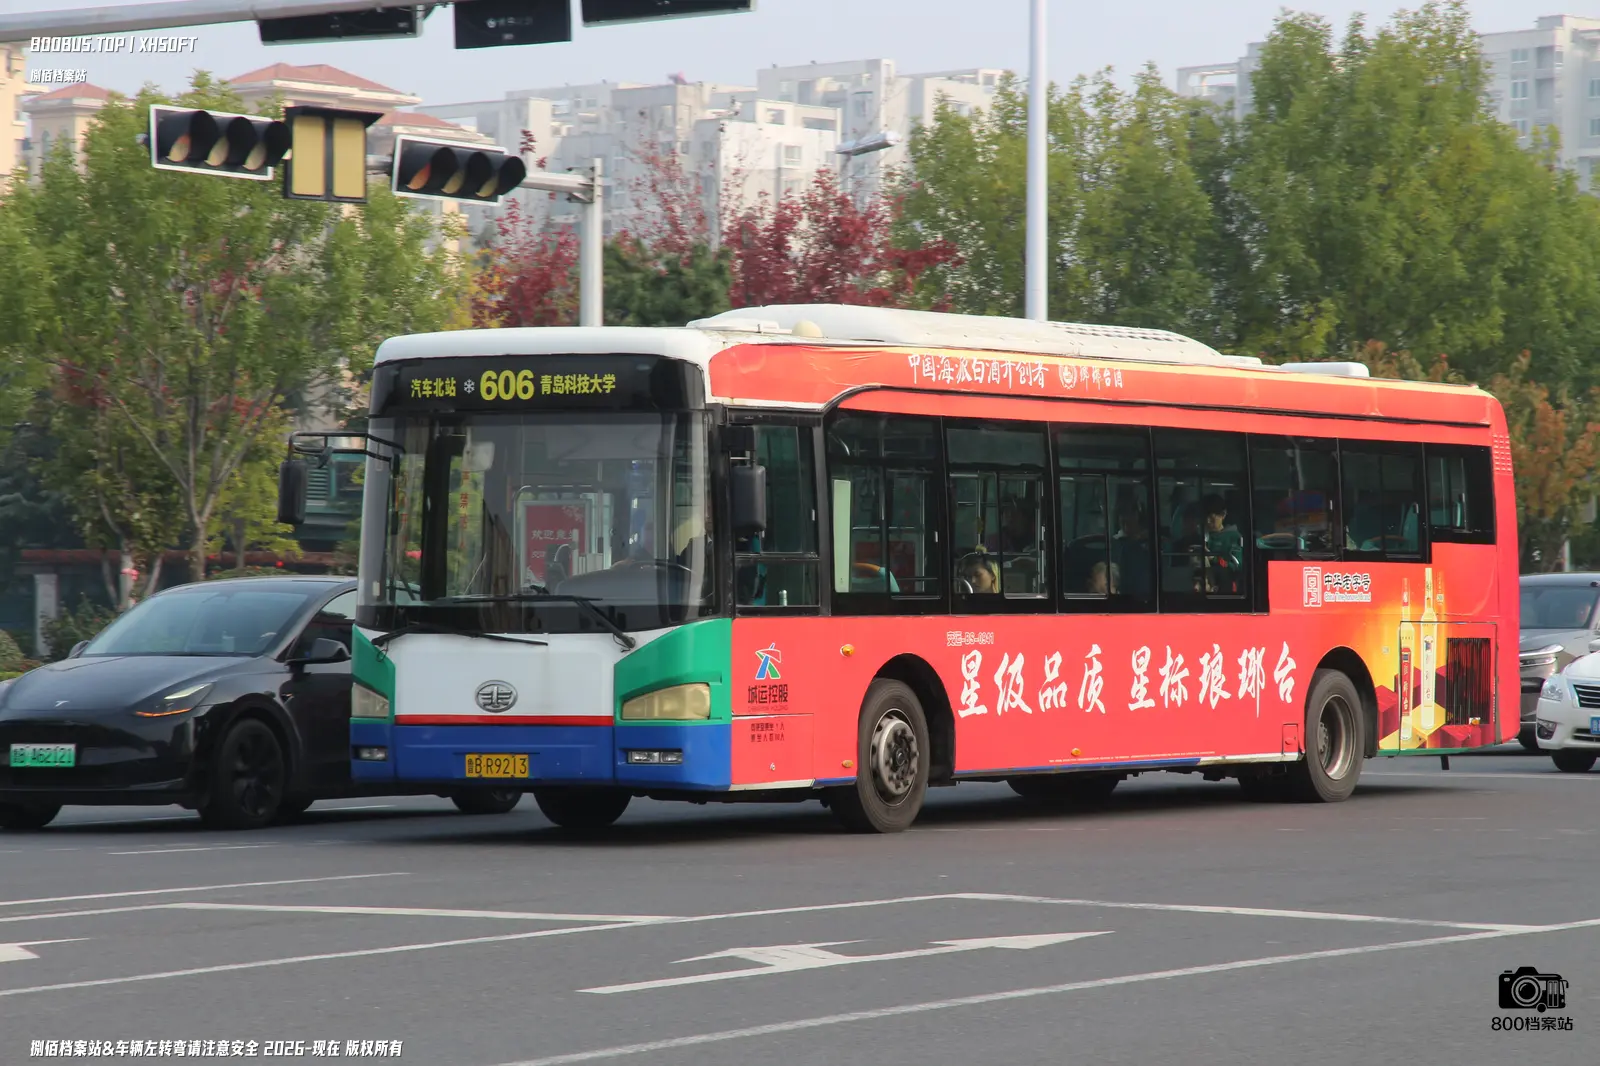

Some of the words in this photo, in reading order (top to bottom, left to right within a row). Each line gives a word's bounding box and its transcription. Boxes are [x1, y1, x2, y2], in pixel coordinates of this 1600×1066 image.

[411, 377, 457, 398] 汽车北站
[480, 369, 535, 401] 606
[540, 374, 616, 395] 青岛科技大学
[907, 353, 1049, 389] 中国海派白酒开创者
[1324, 572, 1372, 591] 中华老字号
[747, 684, 789, 704] 城运控股
[958, 643, 1106, 718] 星级品质
[1128, 640, 1297, 718] 星标琅琊台
